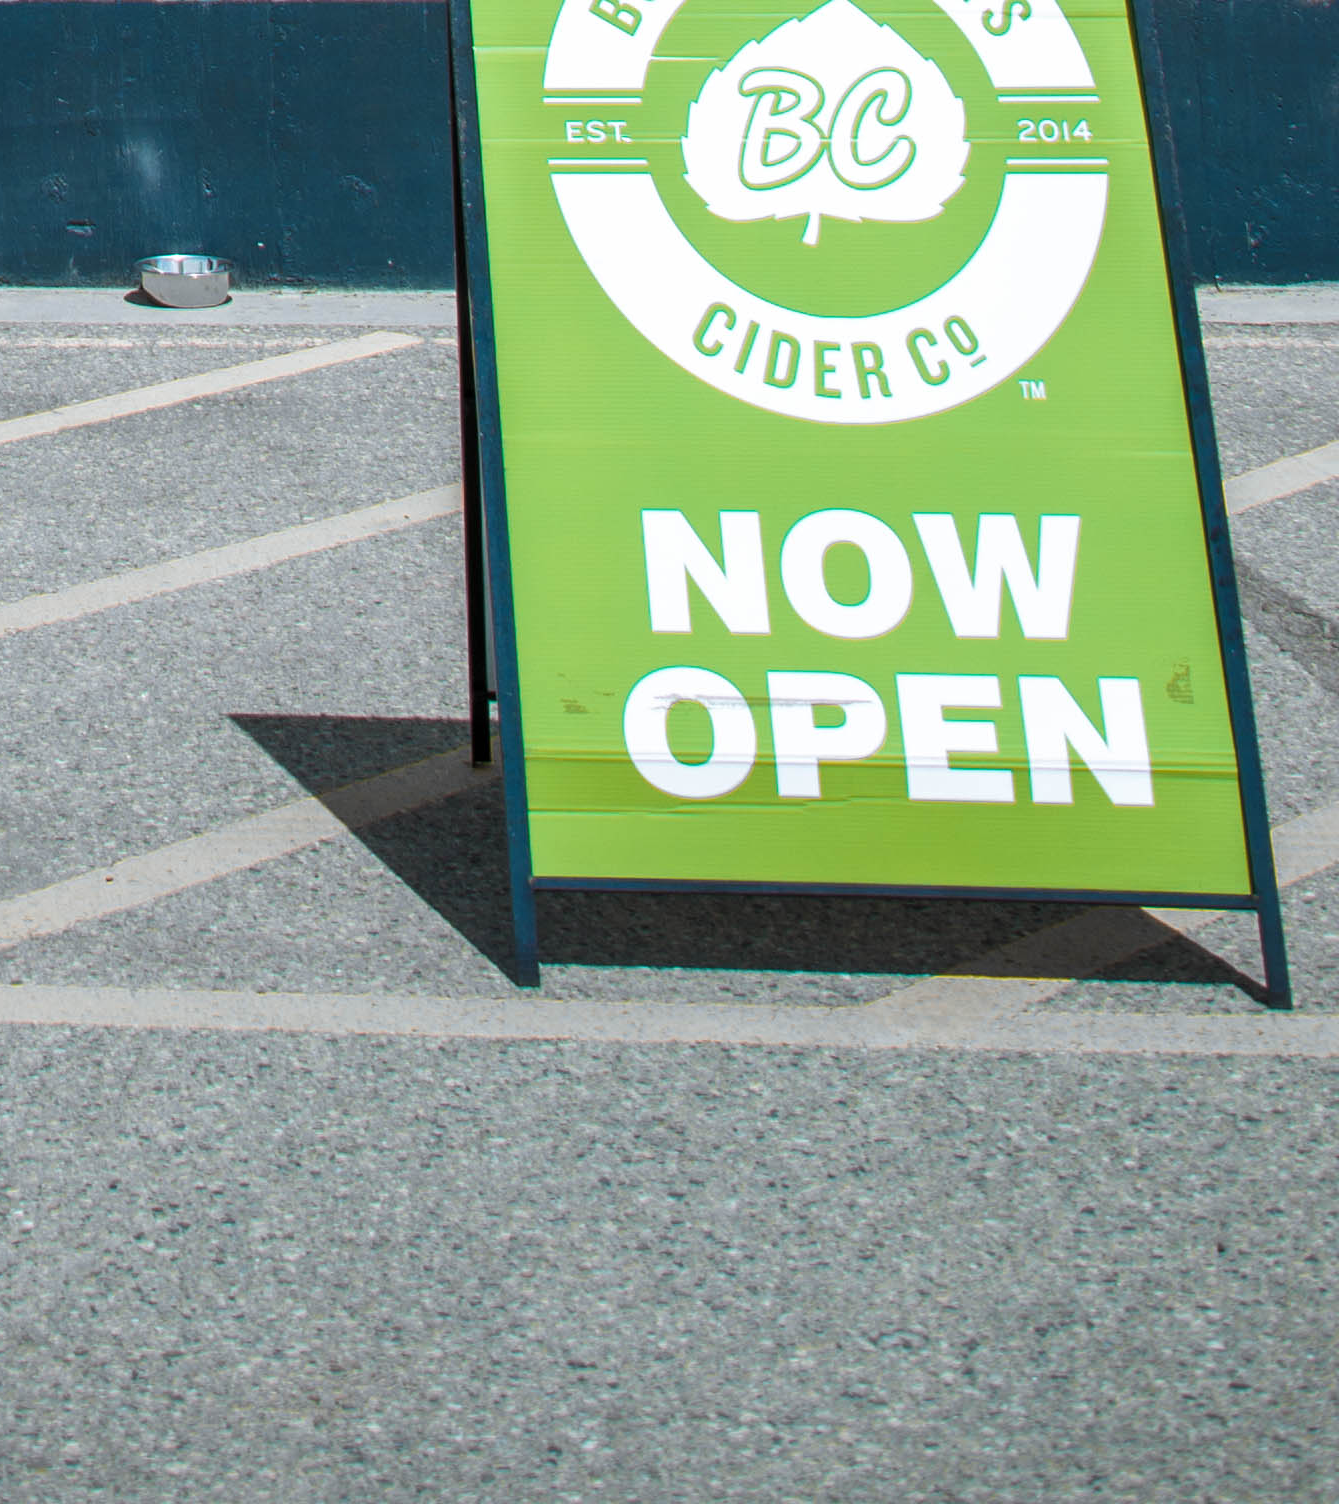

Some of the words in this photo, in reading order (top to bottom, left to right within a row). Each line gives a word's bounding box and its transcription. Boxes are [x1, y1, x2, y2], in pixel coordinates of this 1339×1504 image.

[738, 66, 916, 191] BC
[1017, 119, 1094, 143] 2014
[692, 301, 893, 399] CIDER
[638, 506, 1082, 642] NOW
[620, 663, 1156, 808] OPEN
